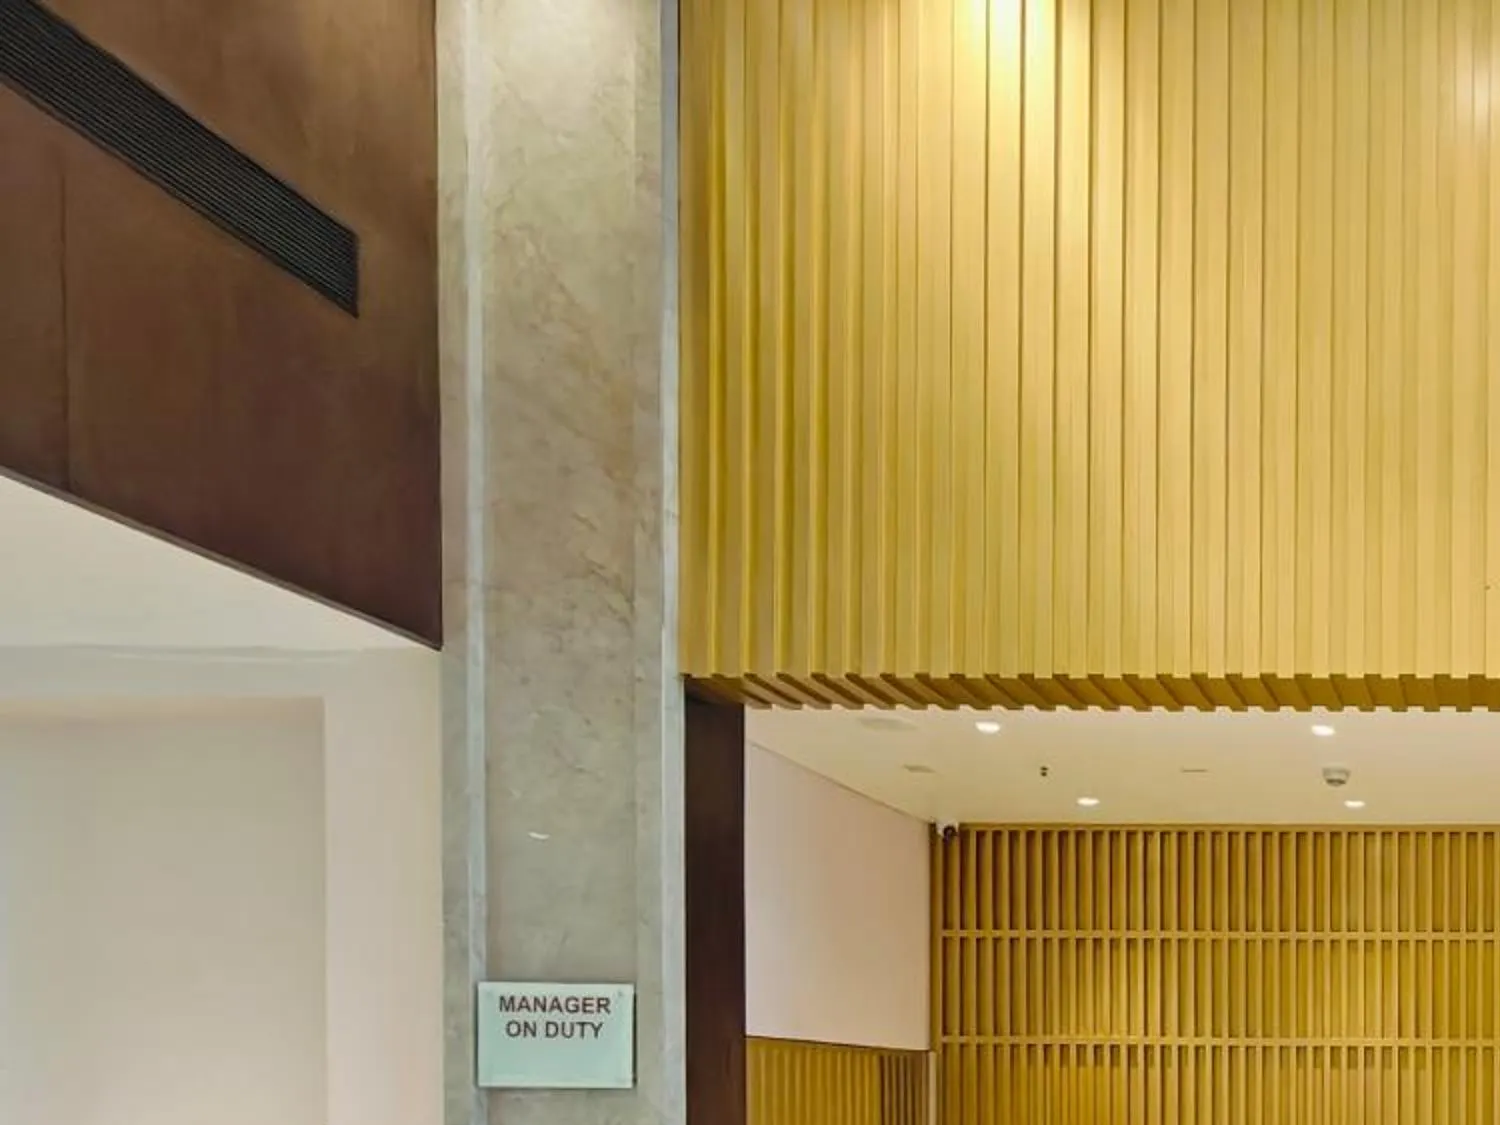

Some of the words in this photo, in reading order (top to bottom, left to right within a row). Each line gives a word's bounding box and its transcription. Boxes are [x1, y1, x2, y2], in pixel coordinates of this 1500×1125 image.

[499, 996, 611, 1014] MANAGER
[505, 1020, 537, 1038] ON
[545, 1021, 604, 1039] DUTY
